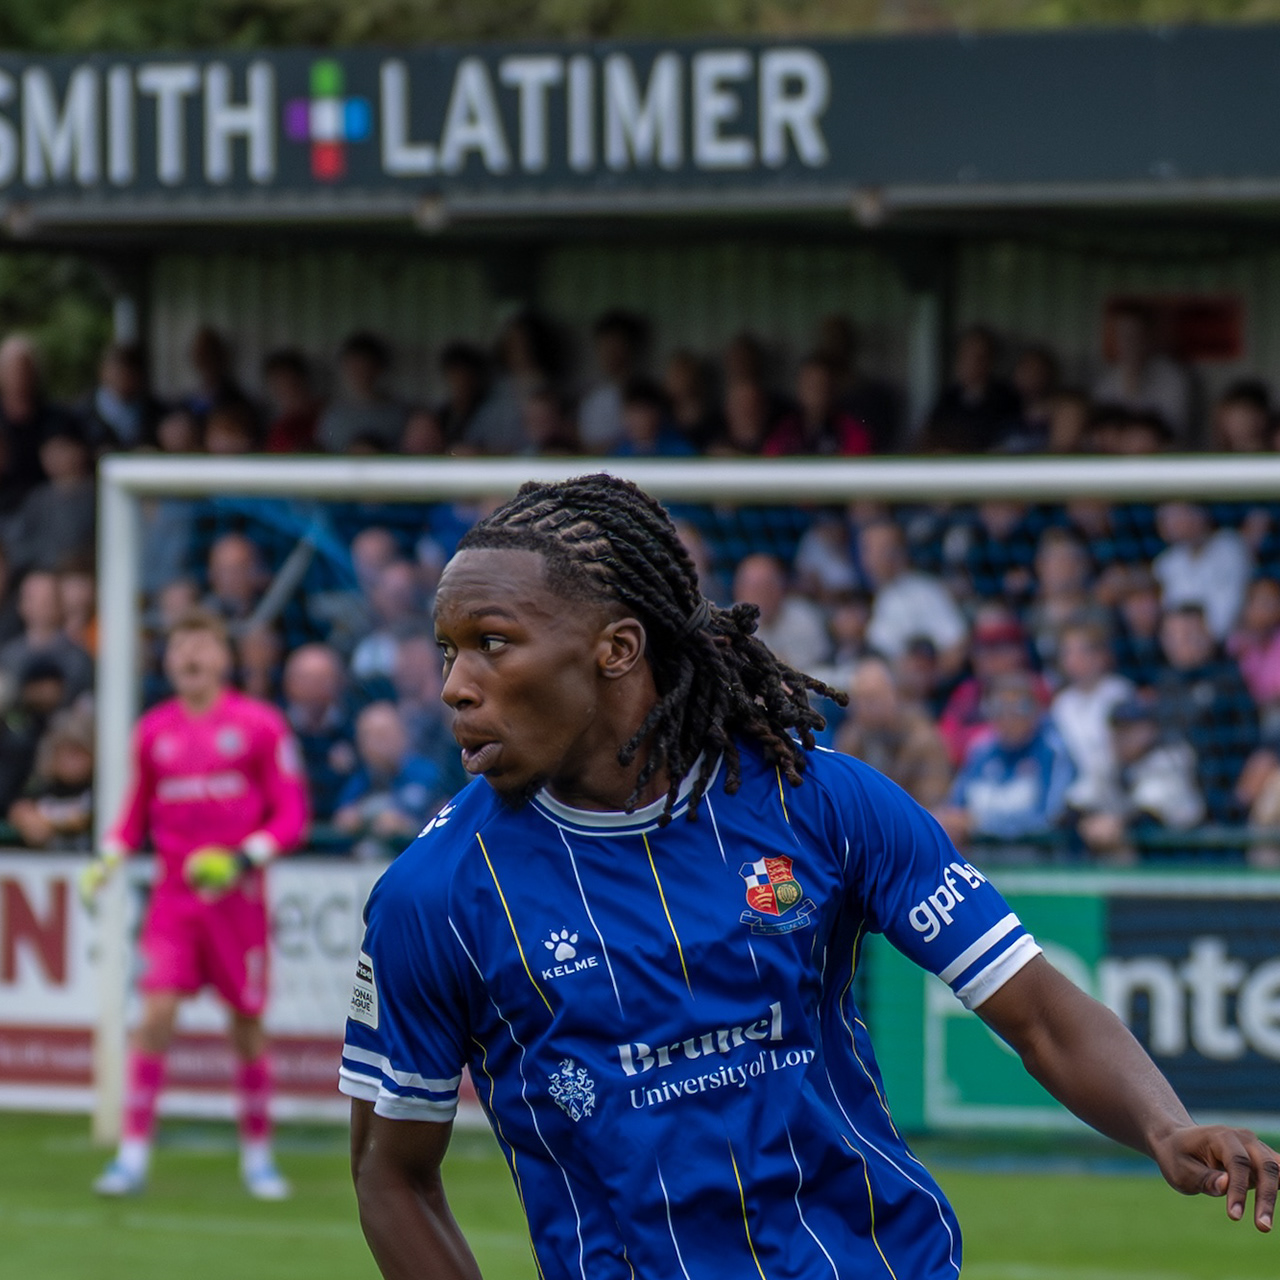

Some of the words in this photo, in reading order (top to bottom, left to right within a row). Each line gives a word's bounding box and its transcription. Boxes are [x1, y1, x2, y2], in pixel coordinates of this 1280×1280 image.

[378, 48, 830, 176] LATIMER
[541, 955, 599, 981] KELME
[617, 1001, 784, 1077] Brunel
[630, 1065, 749, 1109] University
